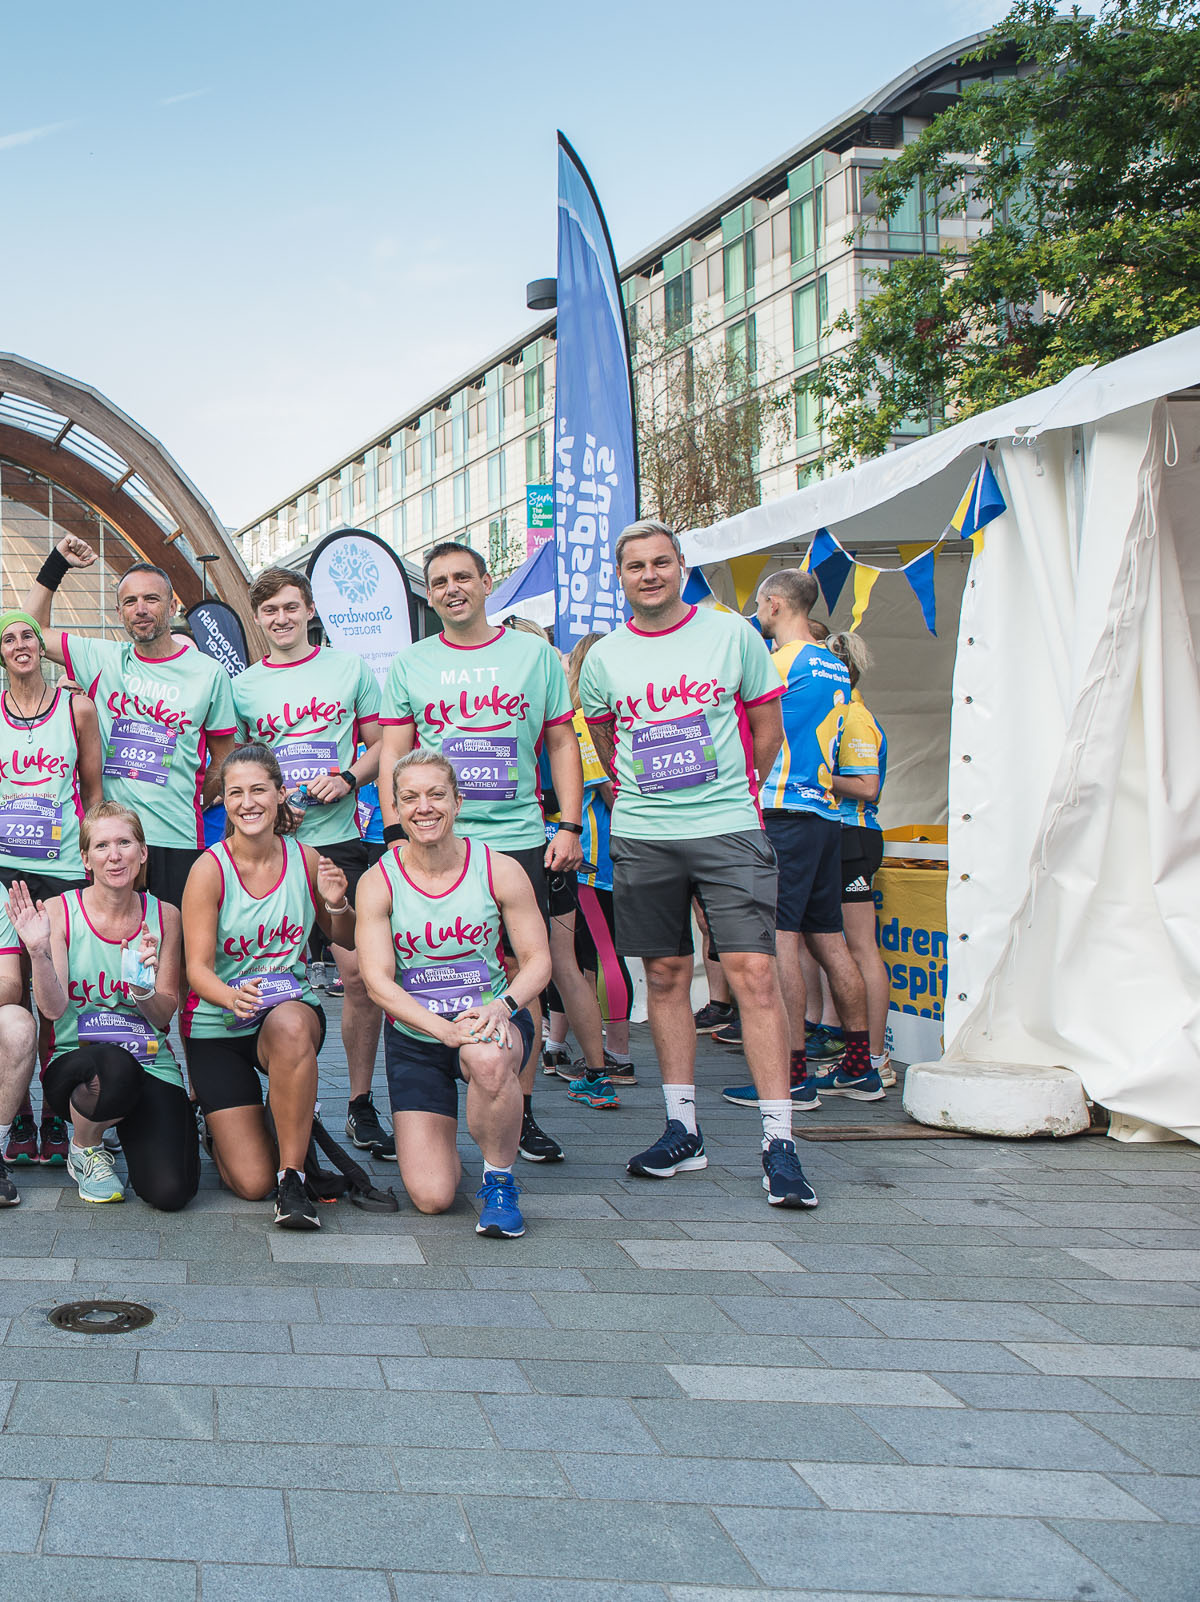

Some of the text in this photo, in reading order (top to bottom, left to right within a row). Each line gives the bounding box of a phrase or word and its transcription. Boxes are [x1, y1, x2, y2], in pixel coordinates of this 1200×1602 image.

[441, 667, 499, 685] MATT
[646, 674, 726, 713] Luke's
[107, 692, 131, 720] St
[424, 685, 530, 734] St Luke's
[257, 697, 346, 743] St Luke's
[12, 747, 70, 778] Luke's
[120, 747, 156, 763] 6832
[652, 750, 696, 770] 5743
[283, 767, 328, 780] 10078
[460, 767, 499, 780] 6921
[652, 764, 701, 779] FOR YOU BRO
[5, 824, 44, 838] 7325
[224, 916, 304, 962] St Luke
[394, 916, 493, 960] St Luke's
[442, 971, 480, 981] MARATHON
[68, 979, 96, 1008] St
[428, 995, 474, 1013] 8179
